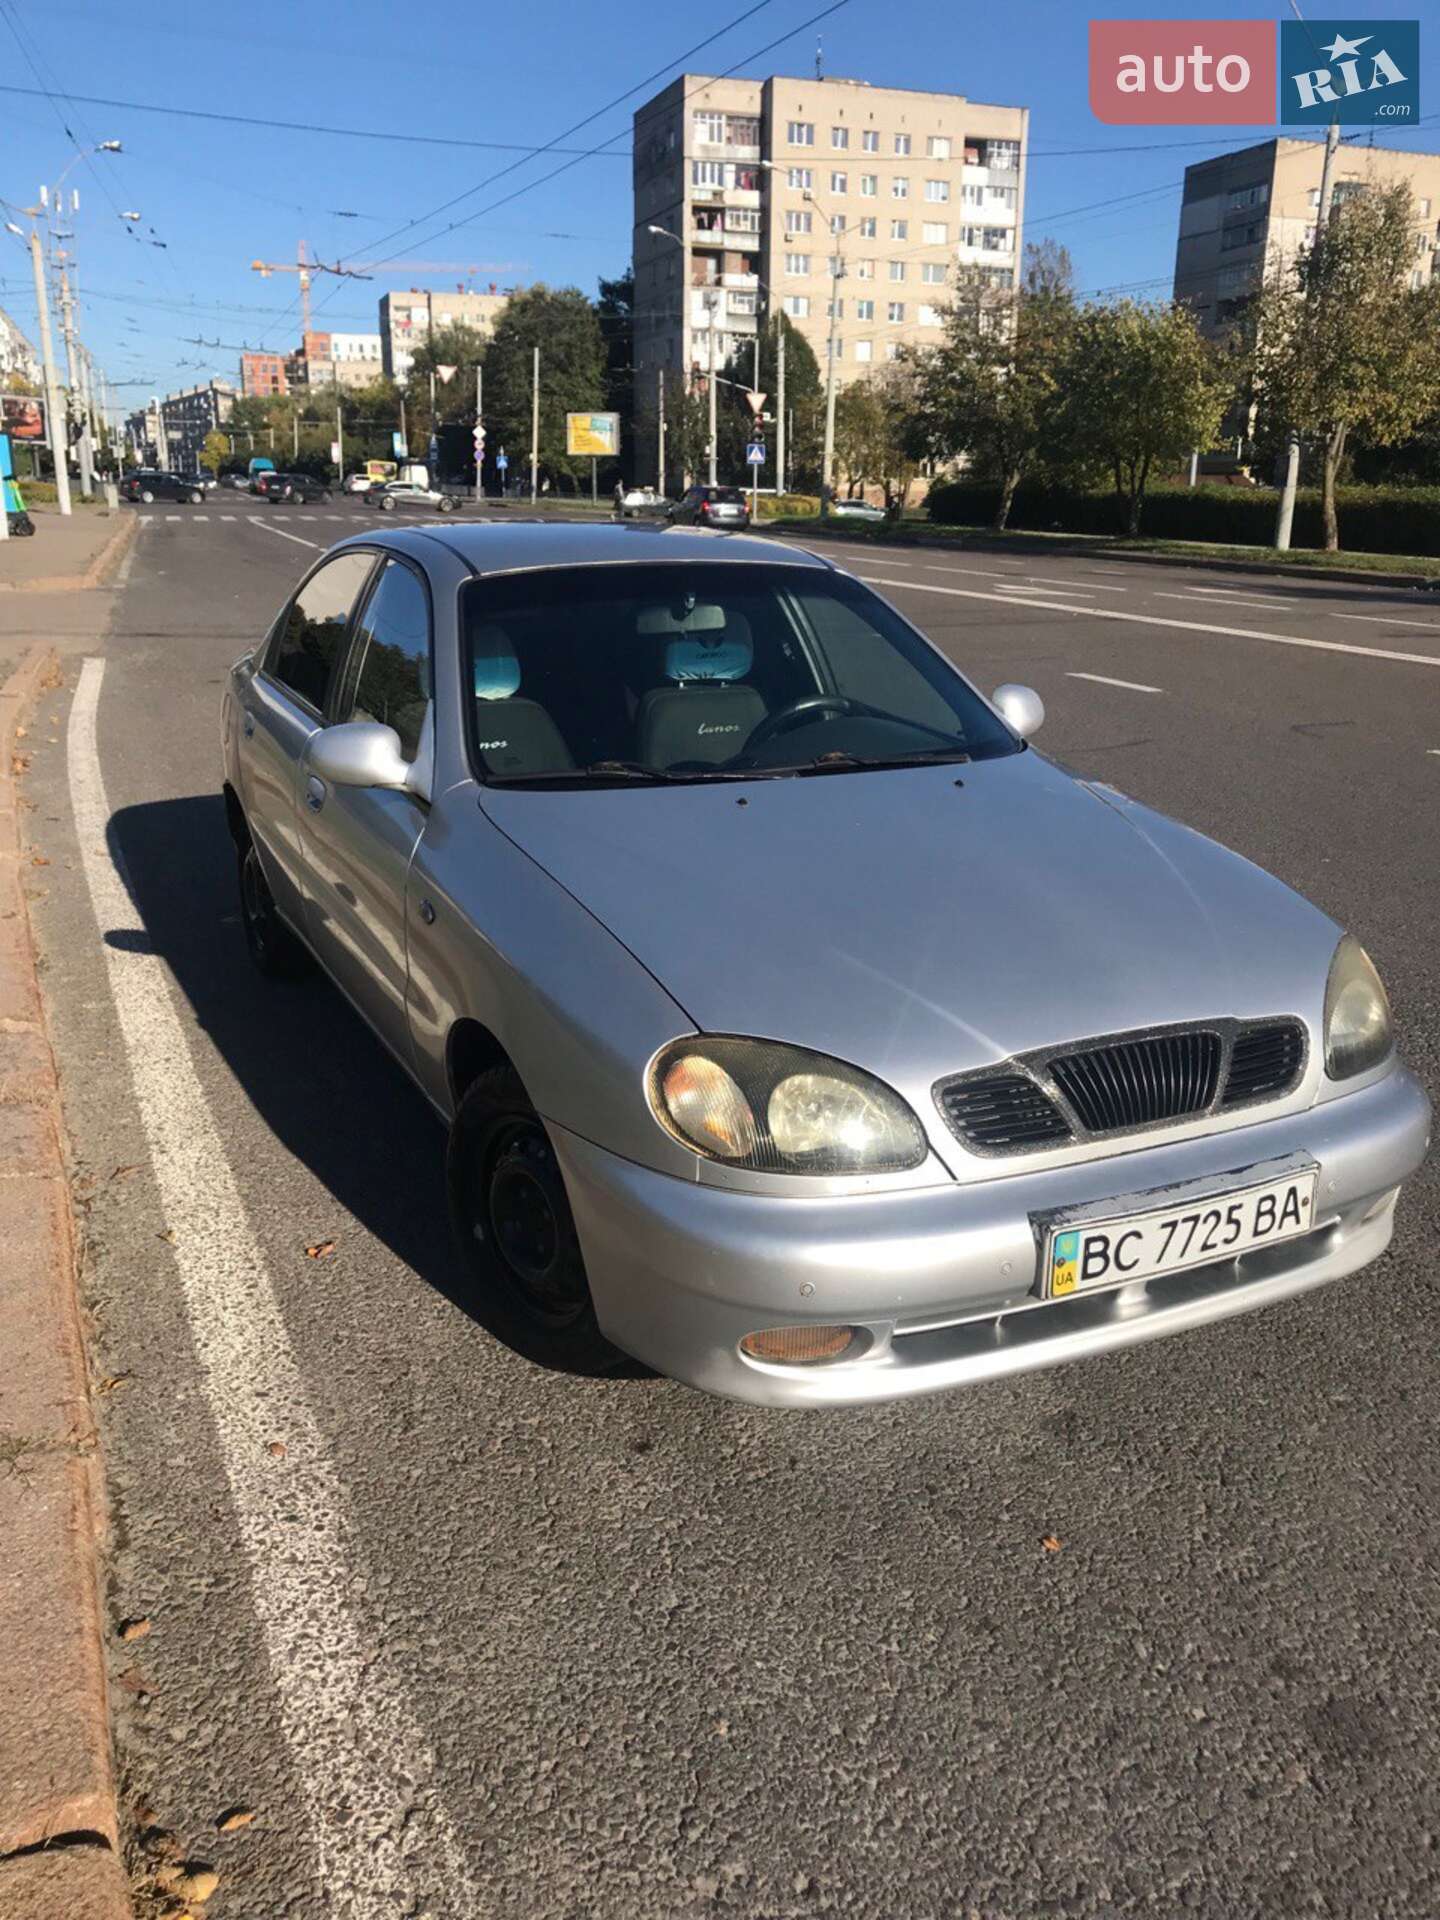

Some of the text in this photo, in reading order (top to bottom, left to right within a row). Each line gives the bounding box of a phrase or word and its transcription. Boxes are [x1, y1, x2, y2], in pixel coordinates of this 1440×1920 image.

[479, 740, 508, 750] nos
[1081, 1186, 1301, 1281] BC 7725 BA
[1055, 1271, 1074, 1286] UA
